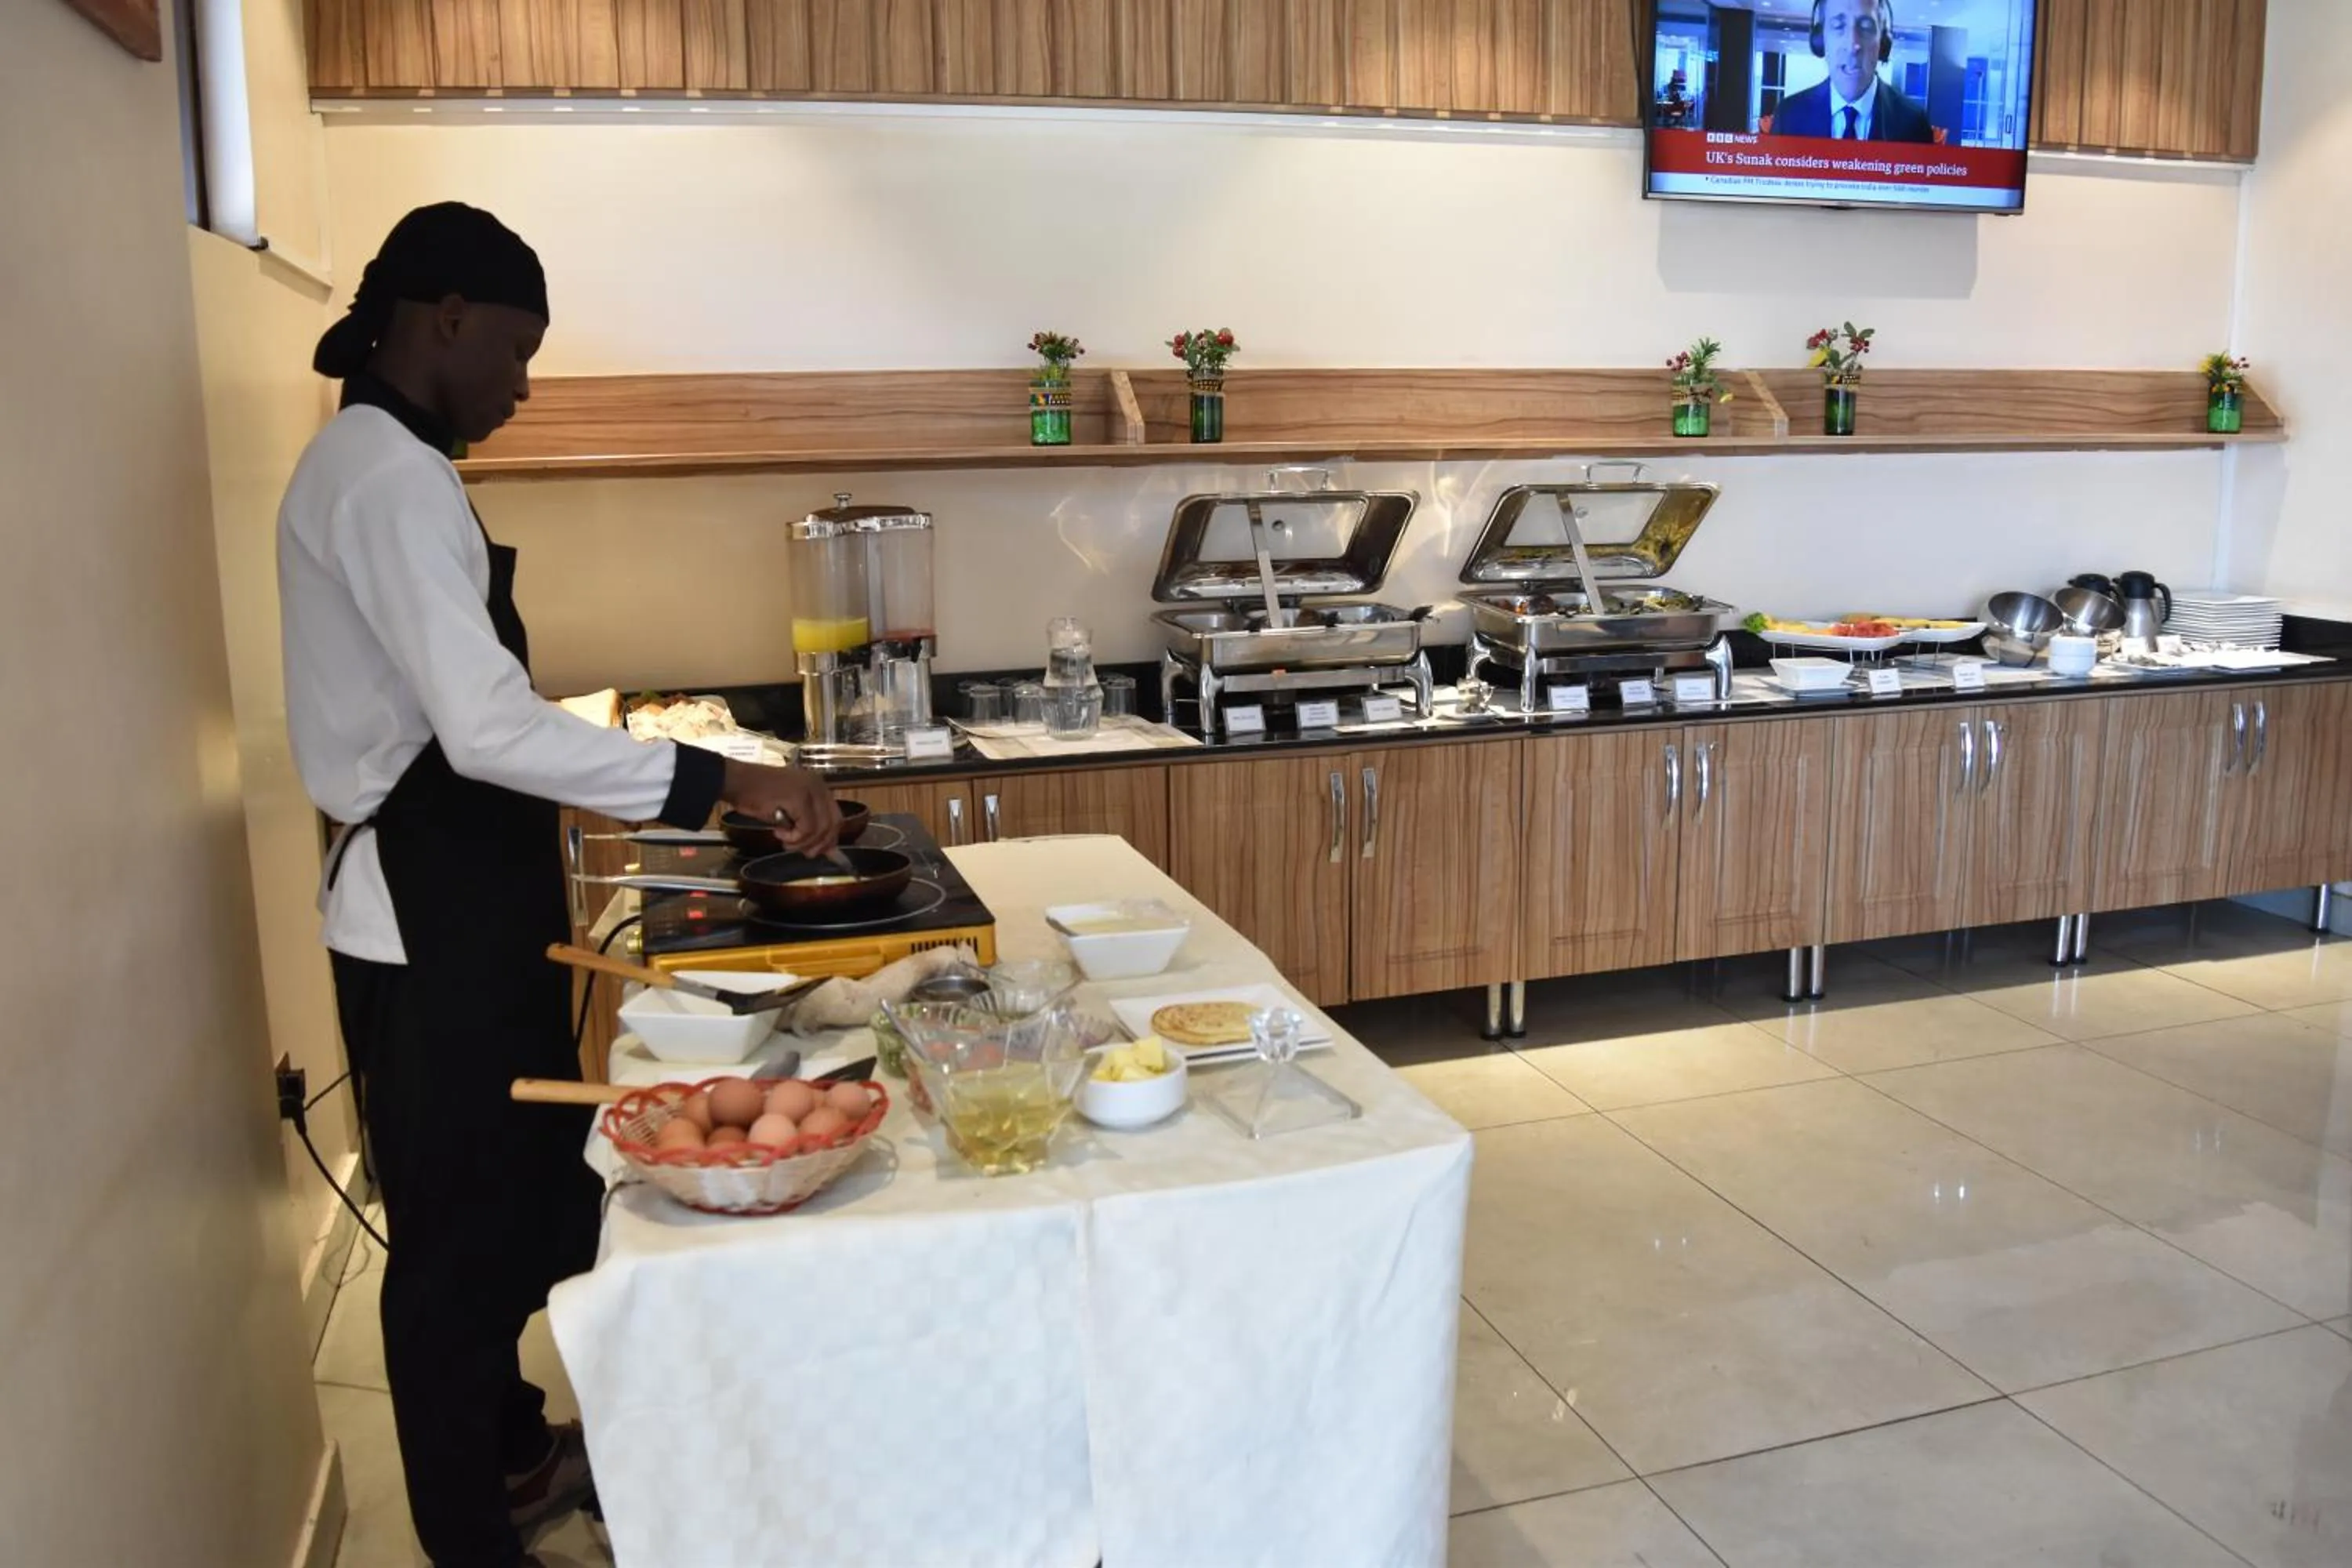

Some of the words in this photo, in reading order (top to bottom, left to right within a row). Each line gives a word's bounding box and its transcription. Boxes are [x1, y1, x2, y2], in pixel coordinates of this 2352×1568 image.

[1734, 134, 1758, 144] NEWS
[1706, 151, 1733, 165] UK's
[1735, 152, 1773, 166] Sunak
[1775, 155, 1830, 169] considers
[1831, 158, 1892, 175] weakening
[1893, 165, 1925, 176] green
[1926, 163, 1968, 178] policies
